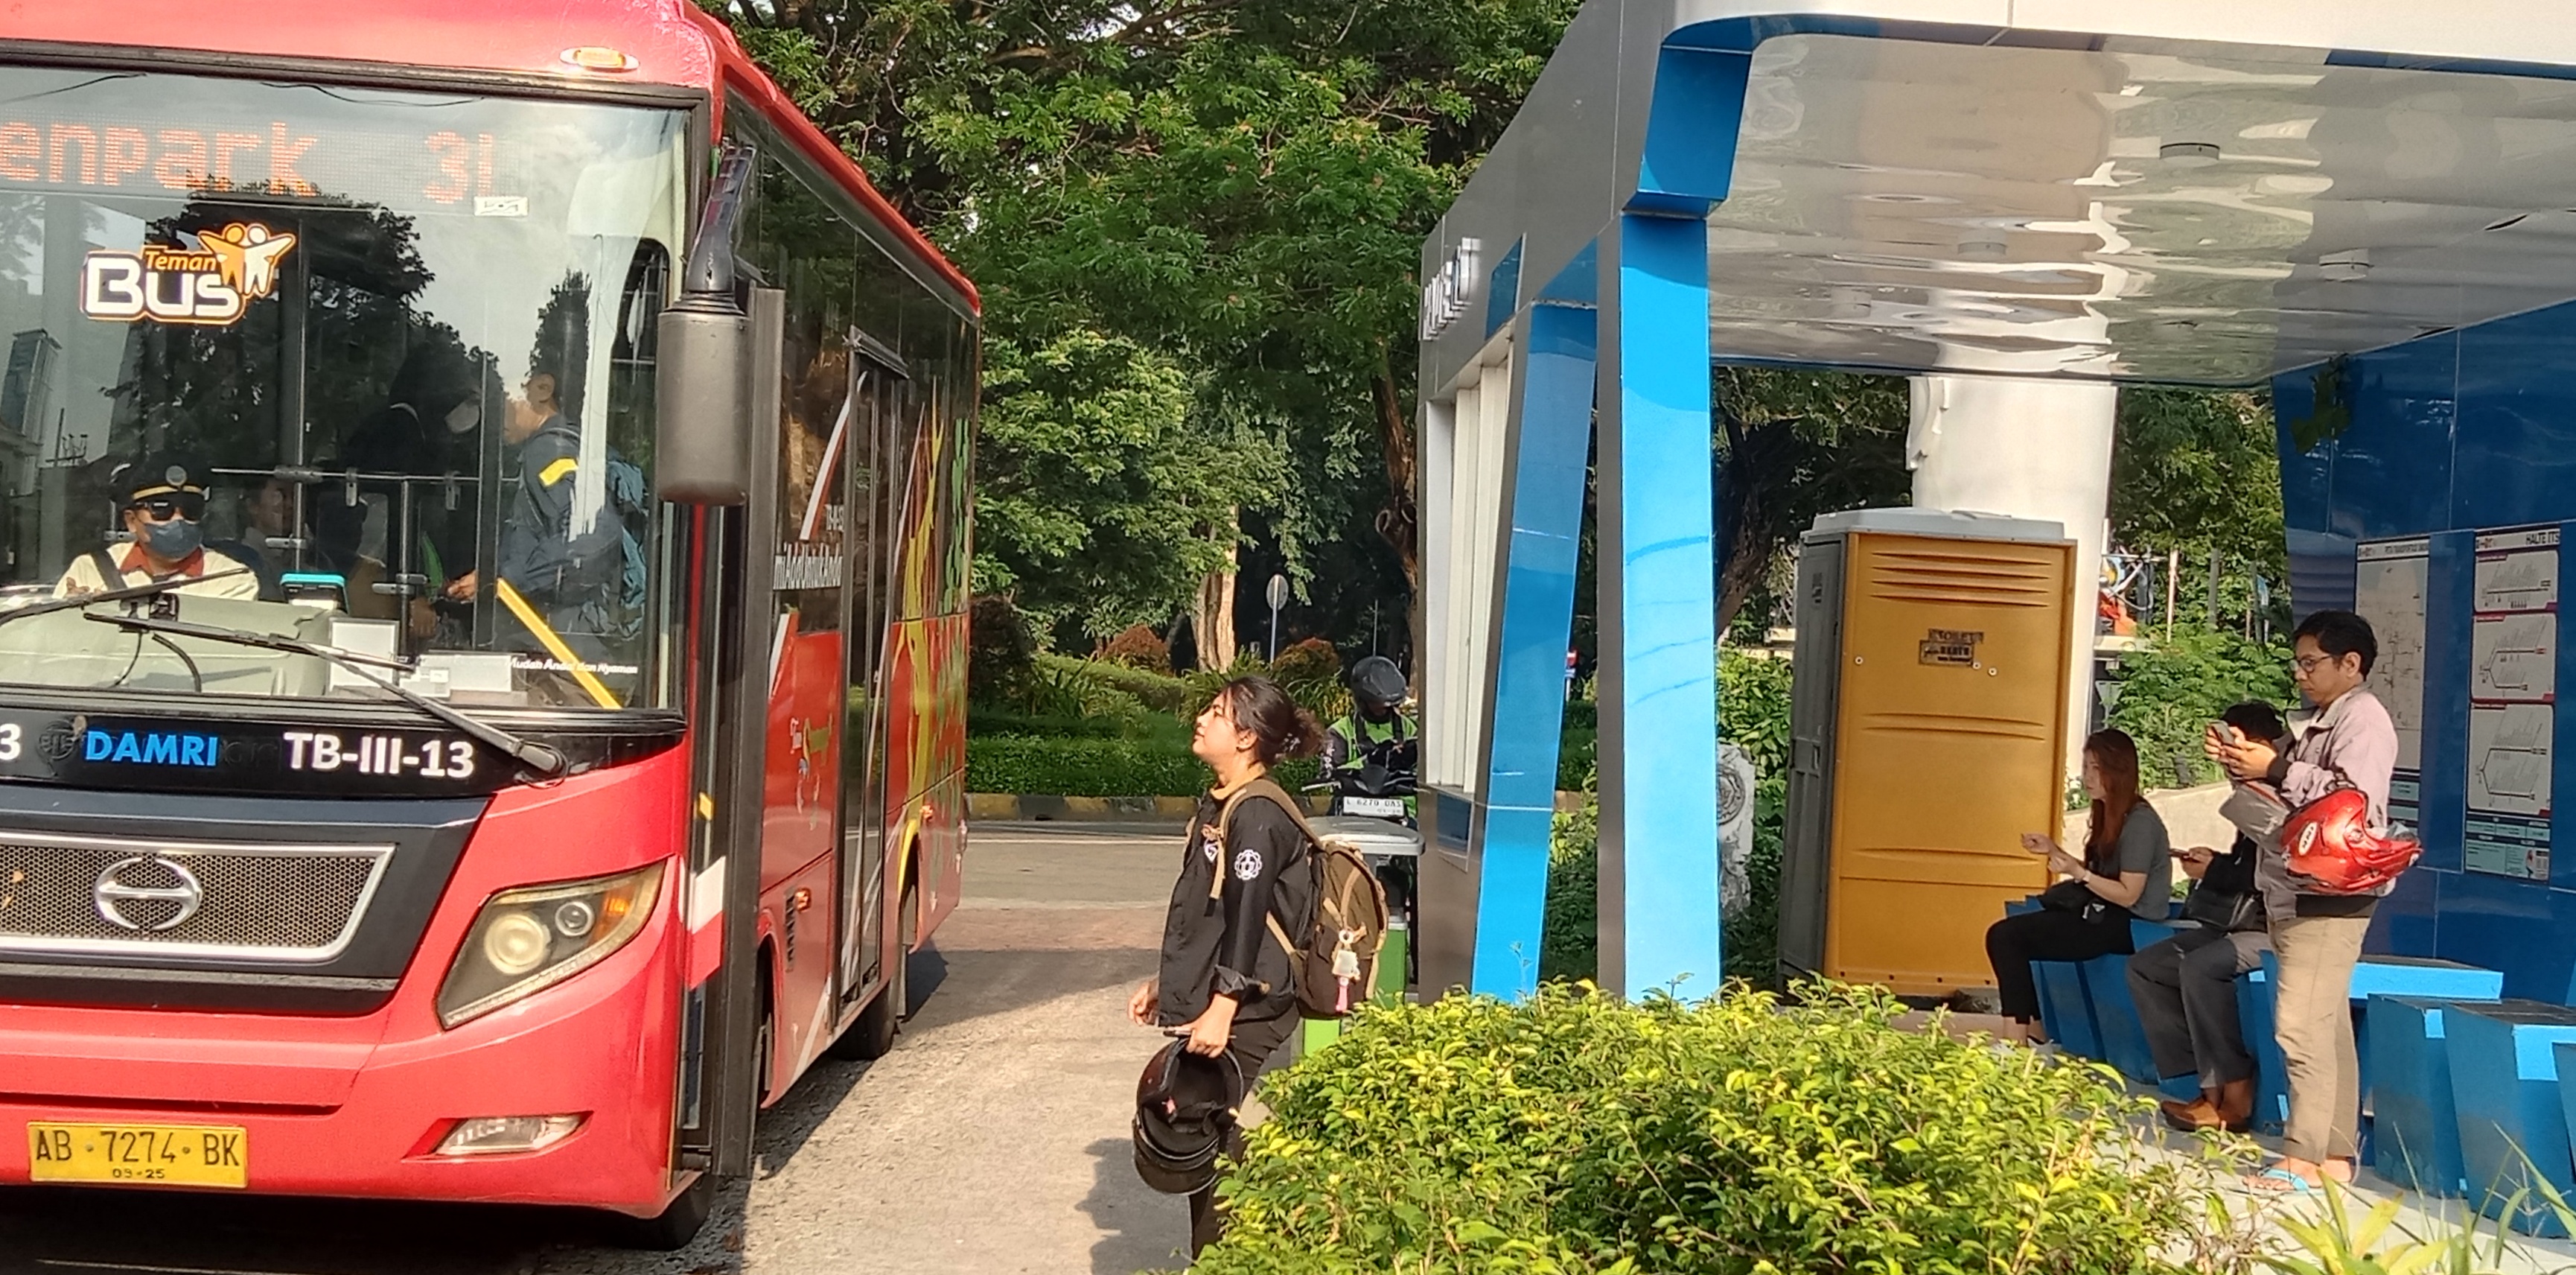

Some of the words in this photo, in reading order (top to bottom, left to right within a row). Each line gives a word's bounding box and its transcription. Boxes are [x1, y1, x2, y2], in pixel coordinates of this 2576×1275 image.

[144, 251, 217, 272] Teman
[2525, 532, 2546, 545] HALTE
[2548, 531, 2560, 543] ITS
[86, 731, 219, 767] DAMRI
[284, 732, 475, 779] TB-III-13
[36, 1130, 72, 1161] AB
[101, 1131, 176, 1163] 7274
[203, 1133, 240, 1166] BK
